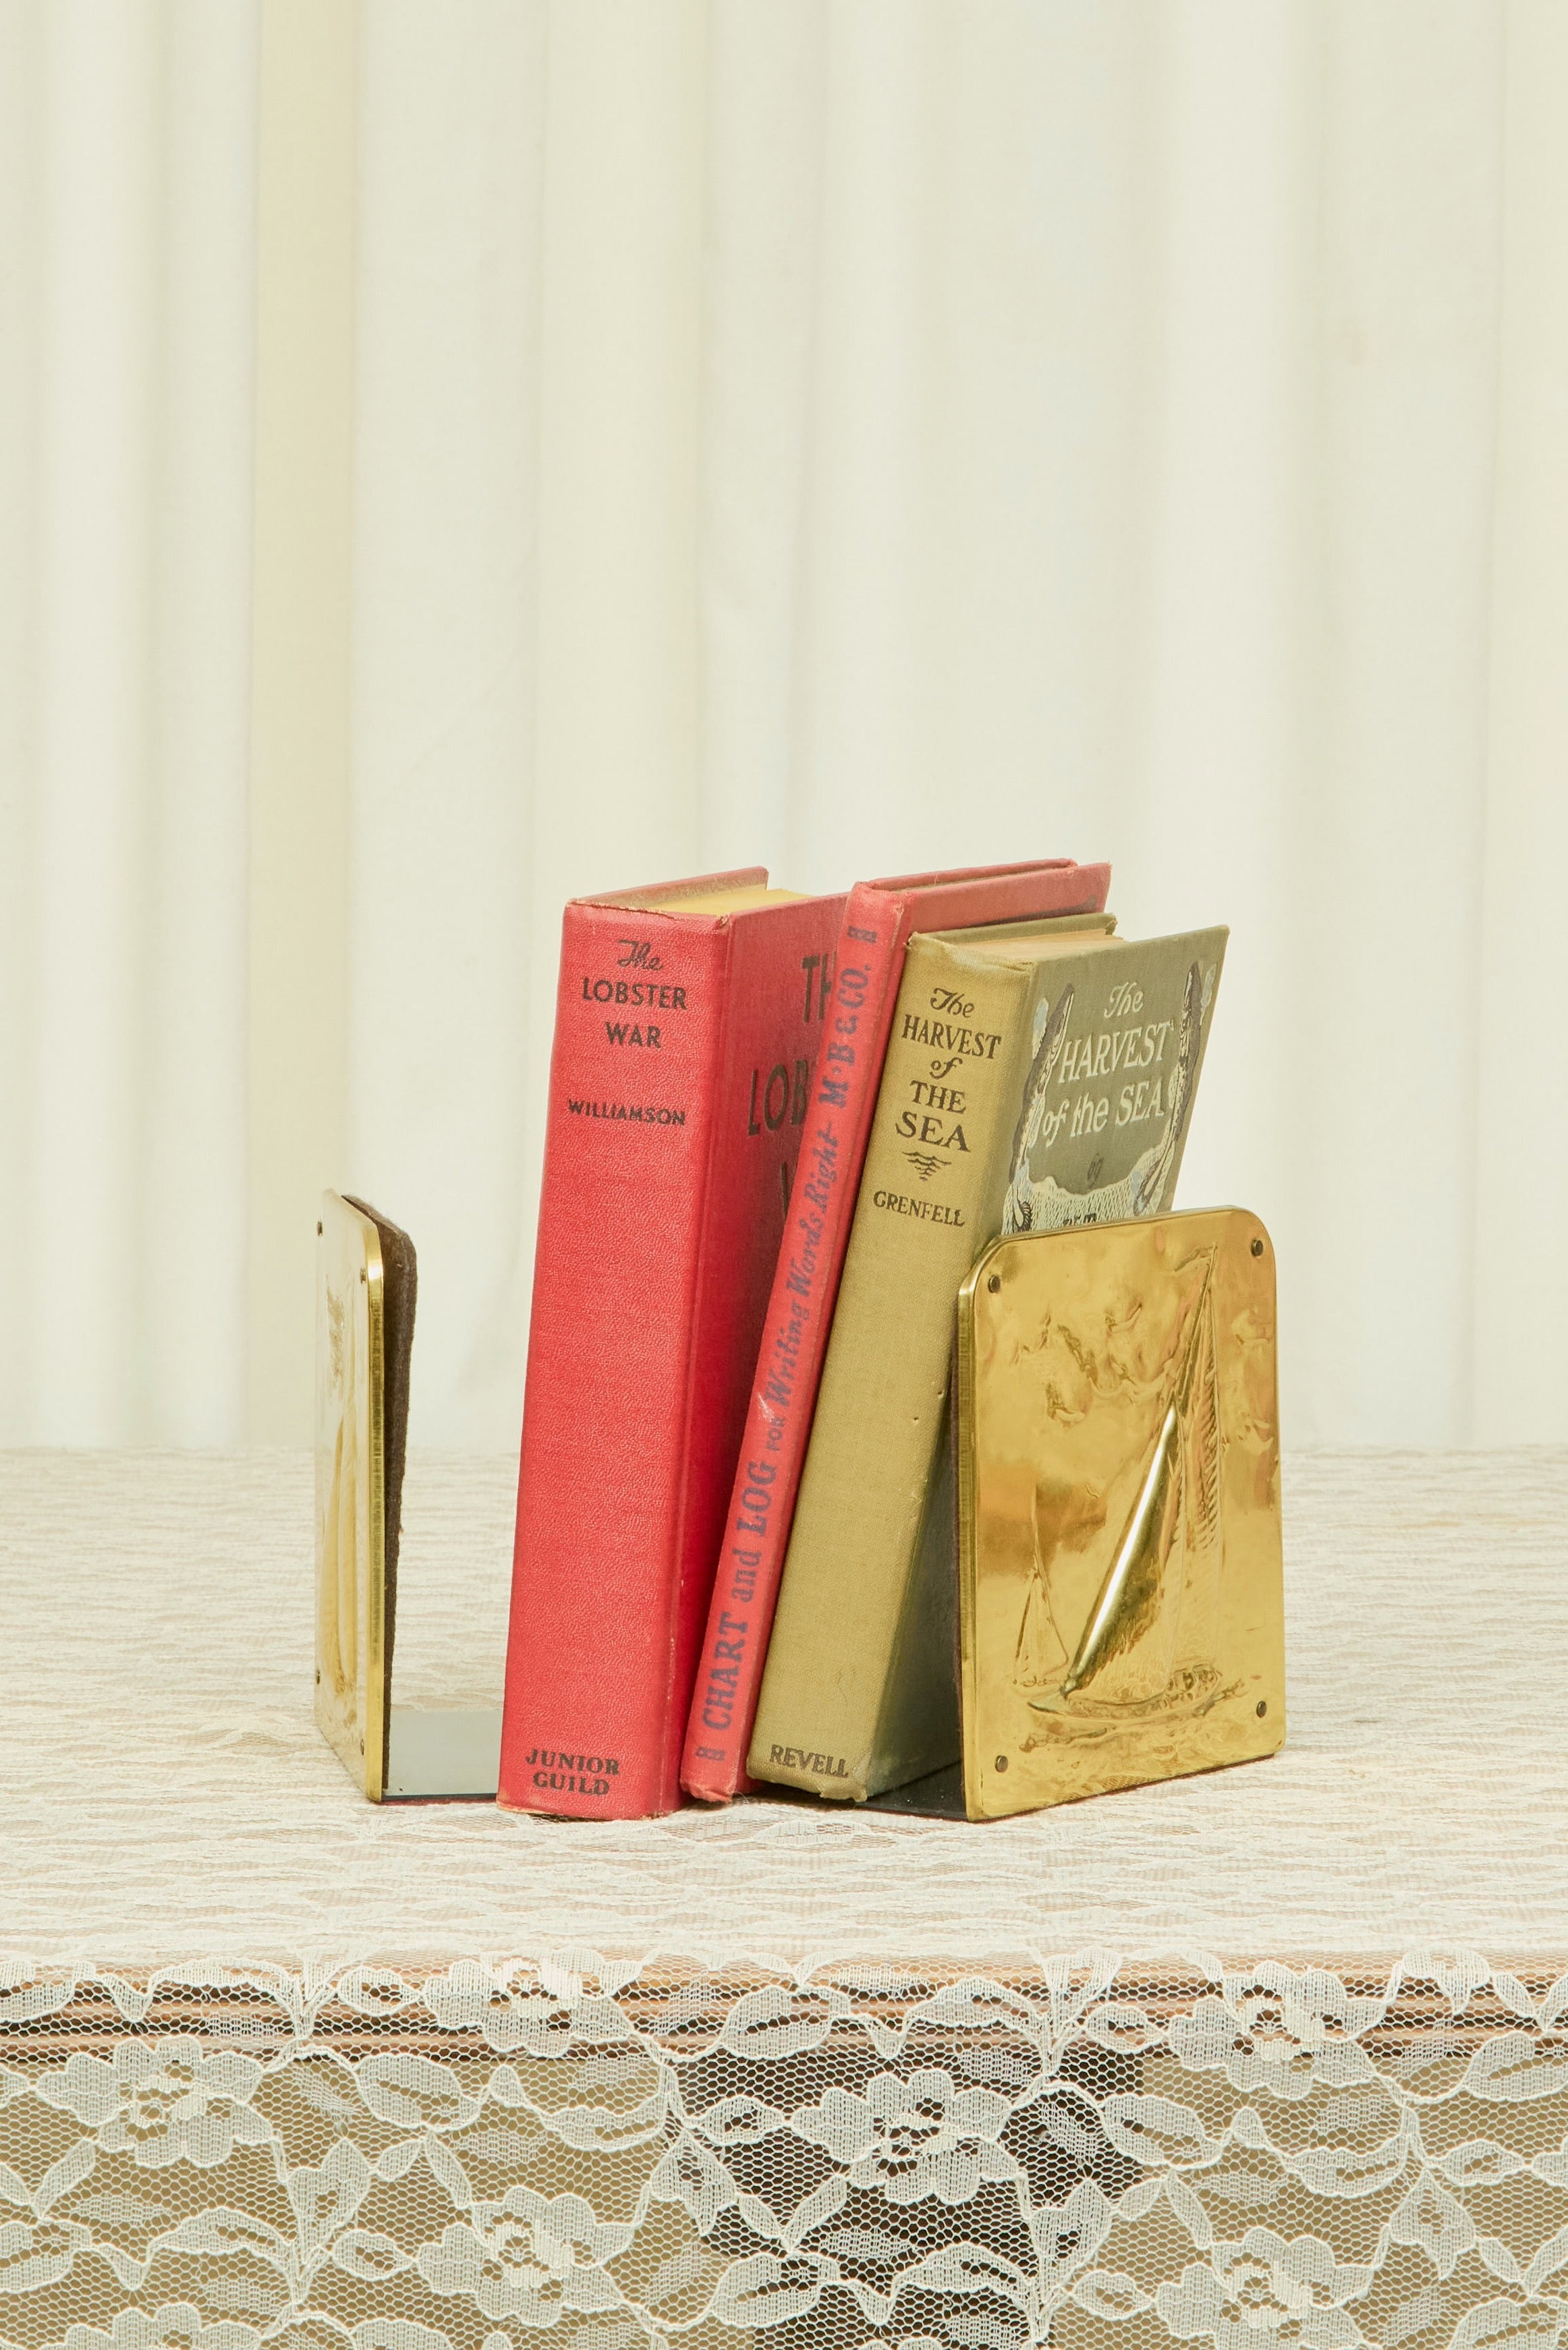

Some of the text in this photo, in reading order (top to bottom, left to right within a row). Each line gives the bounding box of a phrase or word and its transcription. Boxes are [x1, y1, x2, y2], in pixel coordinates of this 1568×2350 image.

[617, 939, 664, 971] The
[582, 977, 688, 1010] LOBSTER
[801, 952, 837, 1024] TH
[837, 963, 872, 1009] CO.
[930, 986, 976, 1018] The
[1104, 980, 1144, 1019] The
[605, 1021, 661, 1048] WAR
[901, 1014, 1002, 1061] HARVEST
[1057, 1020, 1175, 1084] HARVEST
[929, 1057, 963, 1080] of
[567, 1098, 686, 1126] WILLIAMSON
[909, 1080, 966, 1115] THE
[1042, 1078, 1165, 1148] of the SEA
[895, 1111, 972, 1152] SEA
[804, 1121, 839, 1214] Right
[1086, 1152, 1104, 1190] by
[873, 1190, 965, 1227] GRENFELL
[785, 1212, 824, 1297] Words
[763, 1298, 810, 1409] Writing
[766, 1416, 785, 1452] FOR
[736, 1461, 777, 1538] LOG
[731, 1548, 762, 1603] and
[702, 1611, 748, 1731] CHART
[524, 1748, 620, 1777] JUNIOR
[768, 1743, 849, 1779] REVELL
[532, 1770, 610, 1797] GUILD
